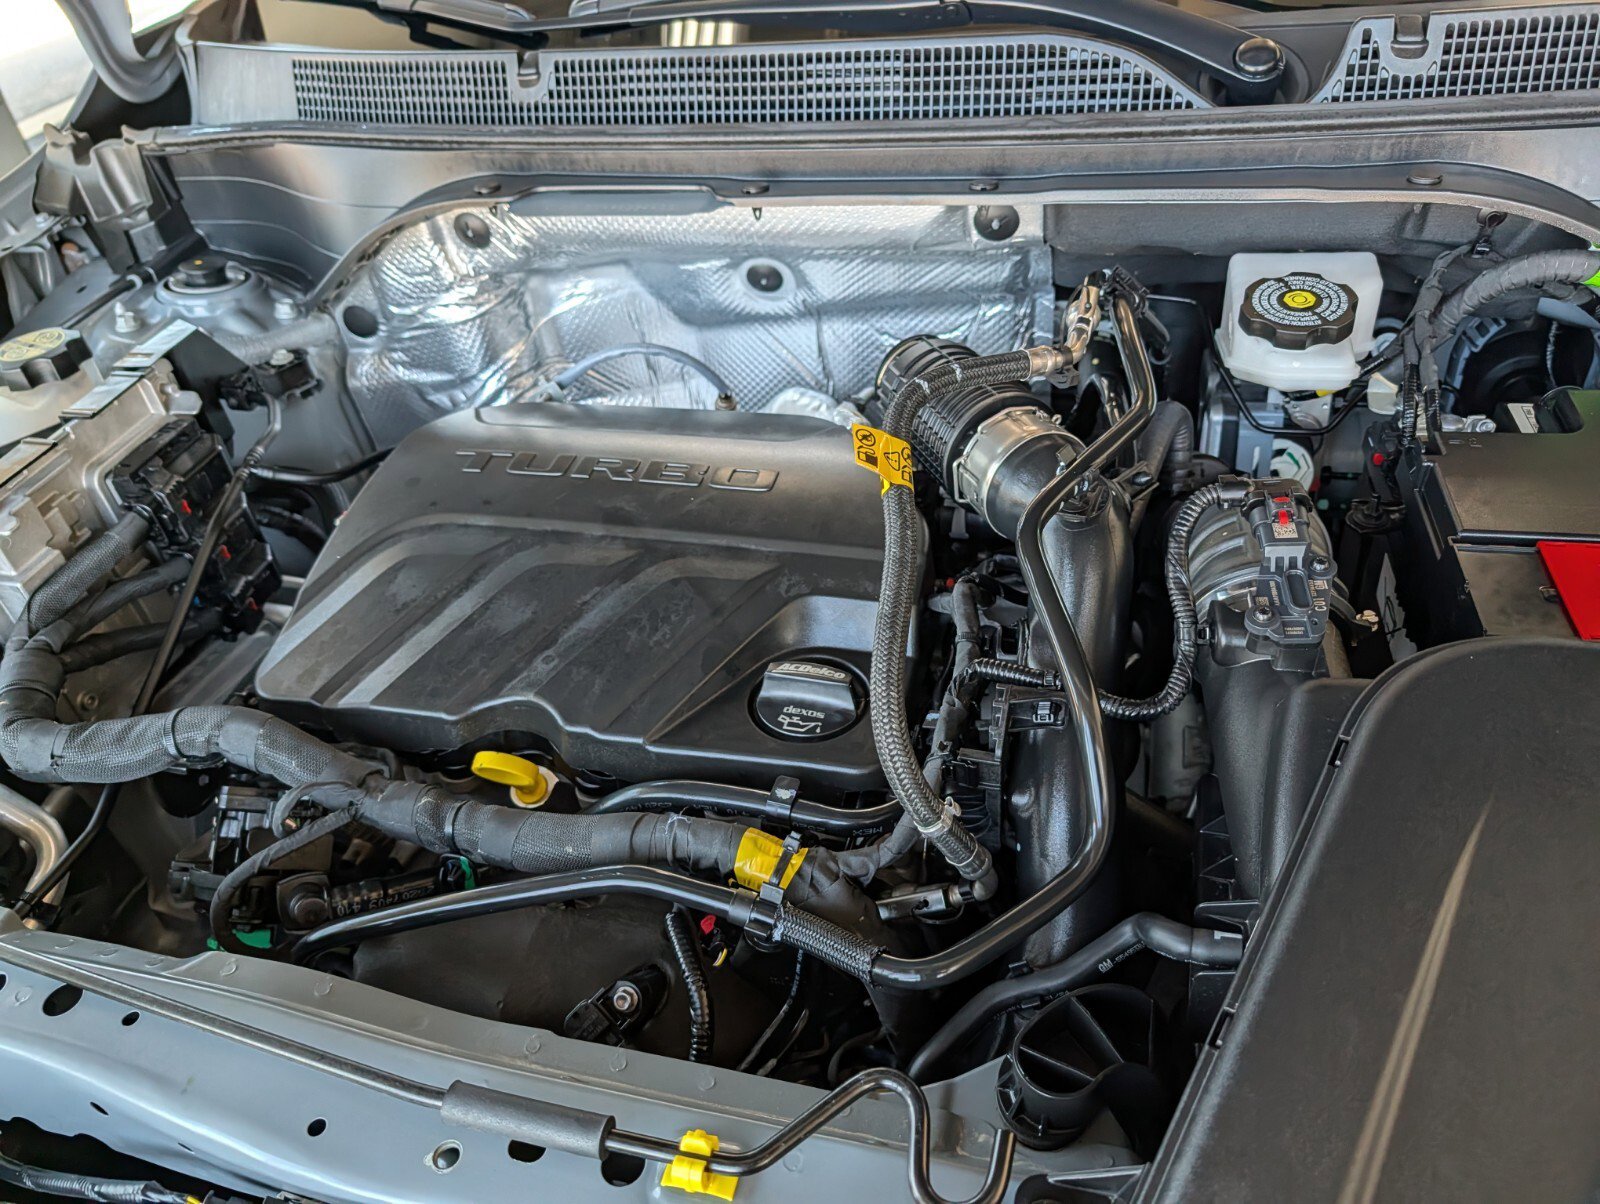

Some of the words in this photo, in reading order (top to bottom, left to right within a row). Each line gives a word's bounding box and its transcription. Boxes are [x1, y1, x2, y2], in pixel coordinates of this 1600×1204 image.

[456, 451, 779, 491] TURBO
[775, 663, 846, 680] ACDelco
[783, 705, 826, 719] dexos
